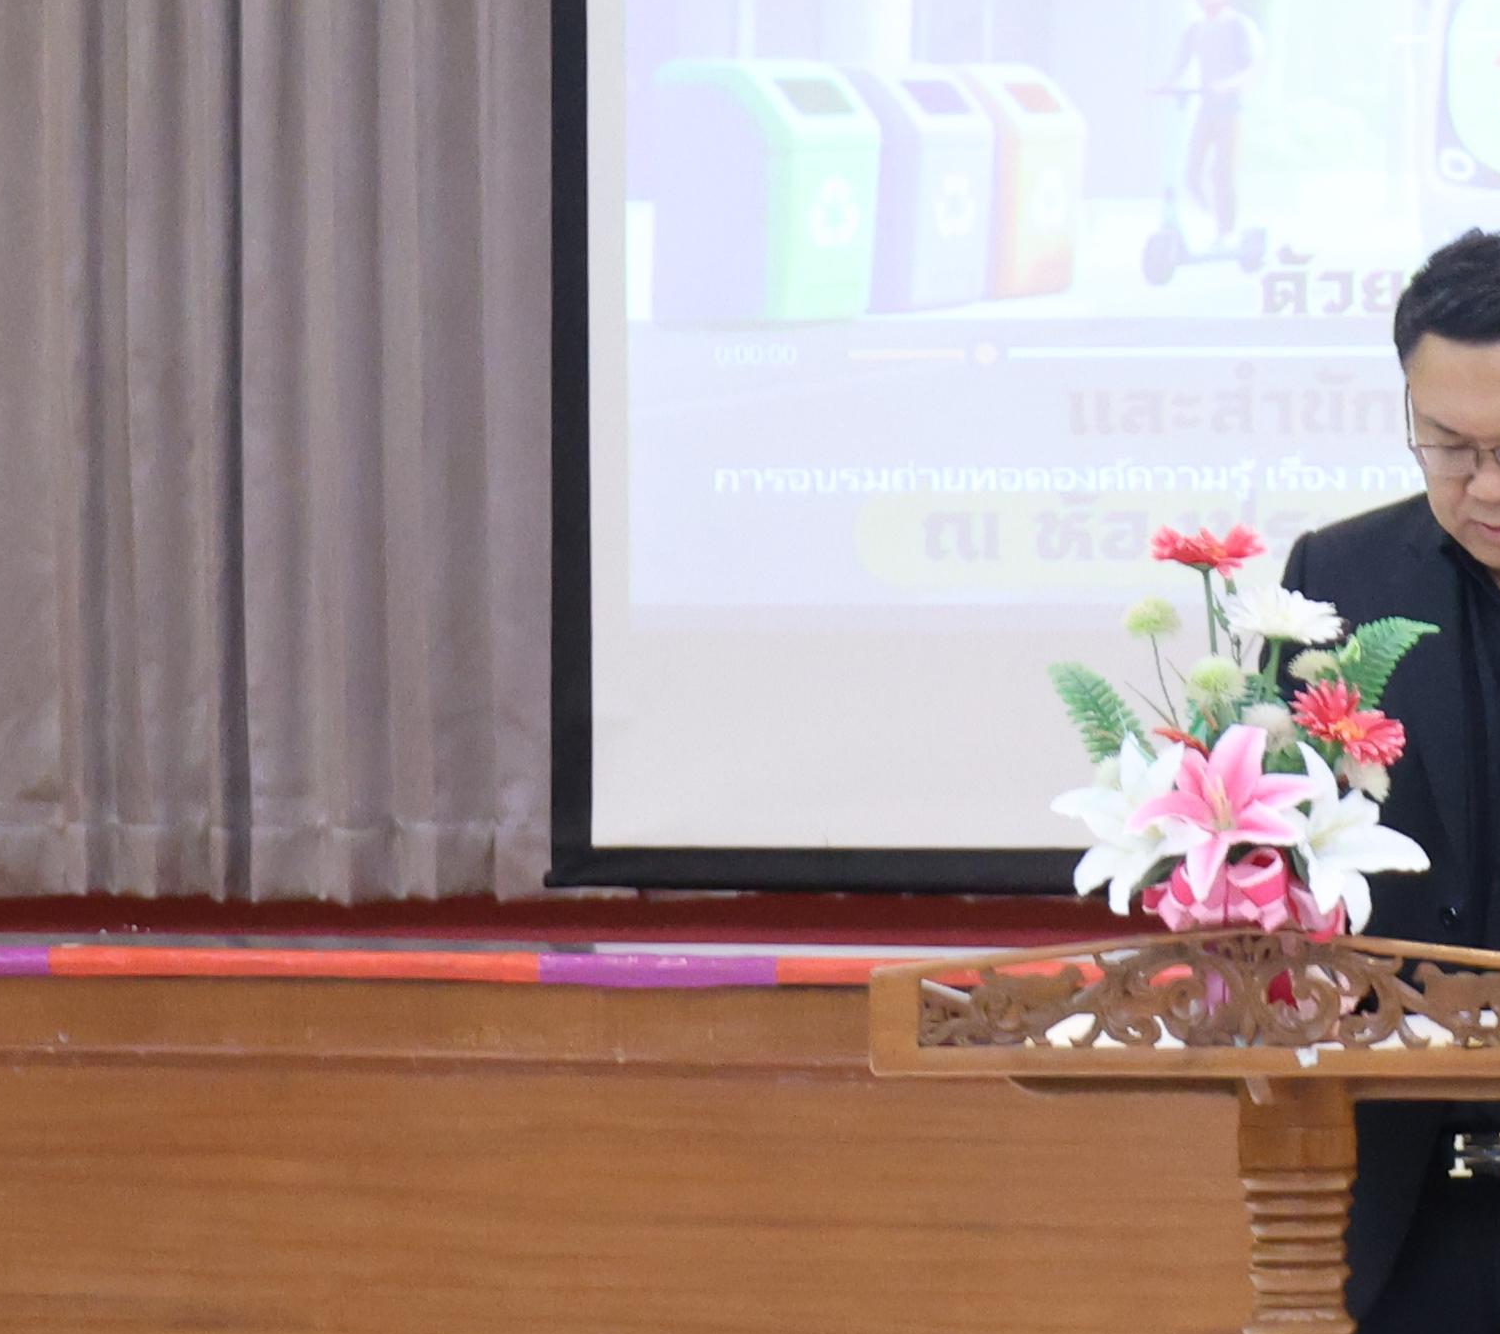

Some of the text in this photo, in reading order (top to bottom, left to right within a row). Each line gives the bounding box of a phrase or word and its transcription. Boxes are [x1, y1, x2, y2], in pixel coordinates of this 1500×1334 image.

[713, 457, 1257, 501] การอบรมถ่ายทอดองค์ความรู้
[921, 509, 1001, 562] ณ
